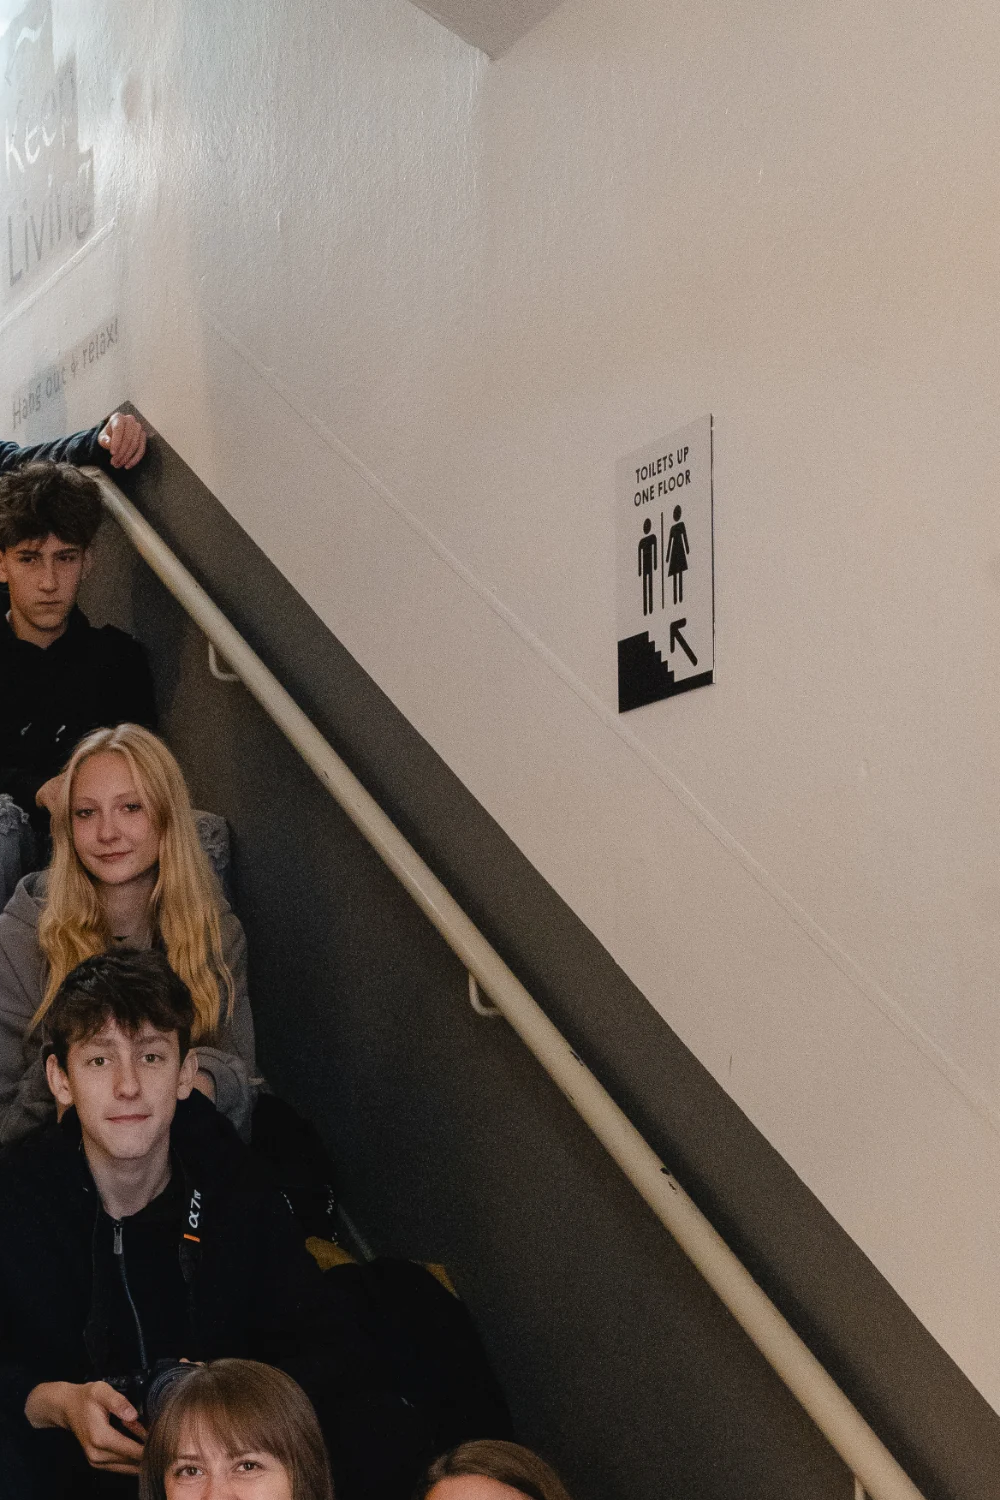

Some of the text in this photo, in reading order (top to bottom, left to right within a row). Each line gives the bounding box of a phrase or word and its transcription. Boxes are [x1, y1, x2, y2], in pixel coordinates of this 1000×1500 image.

[12, 382, 41, 430] Hang
[82, 318, 118, 369] relax!
[635, 446, 690, 484] TOILETS UP
[633, 469, 691, 507] ONE FLOOR
